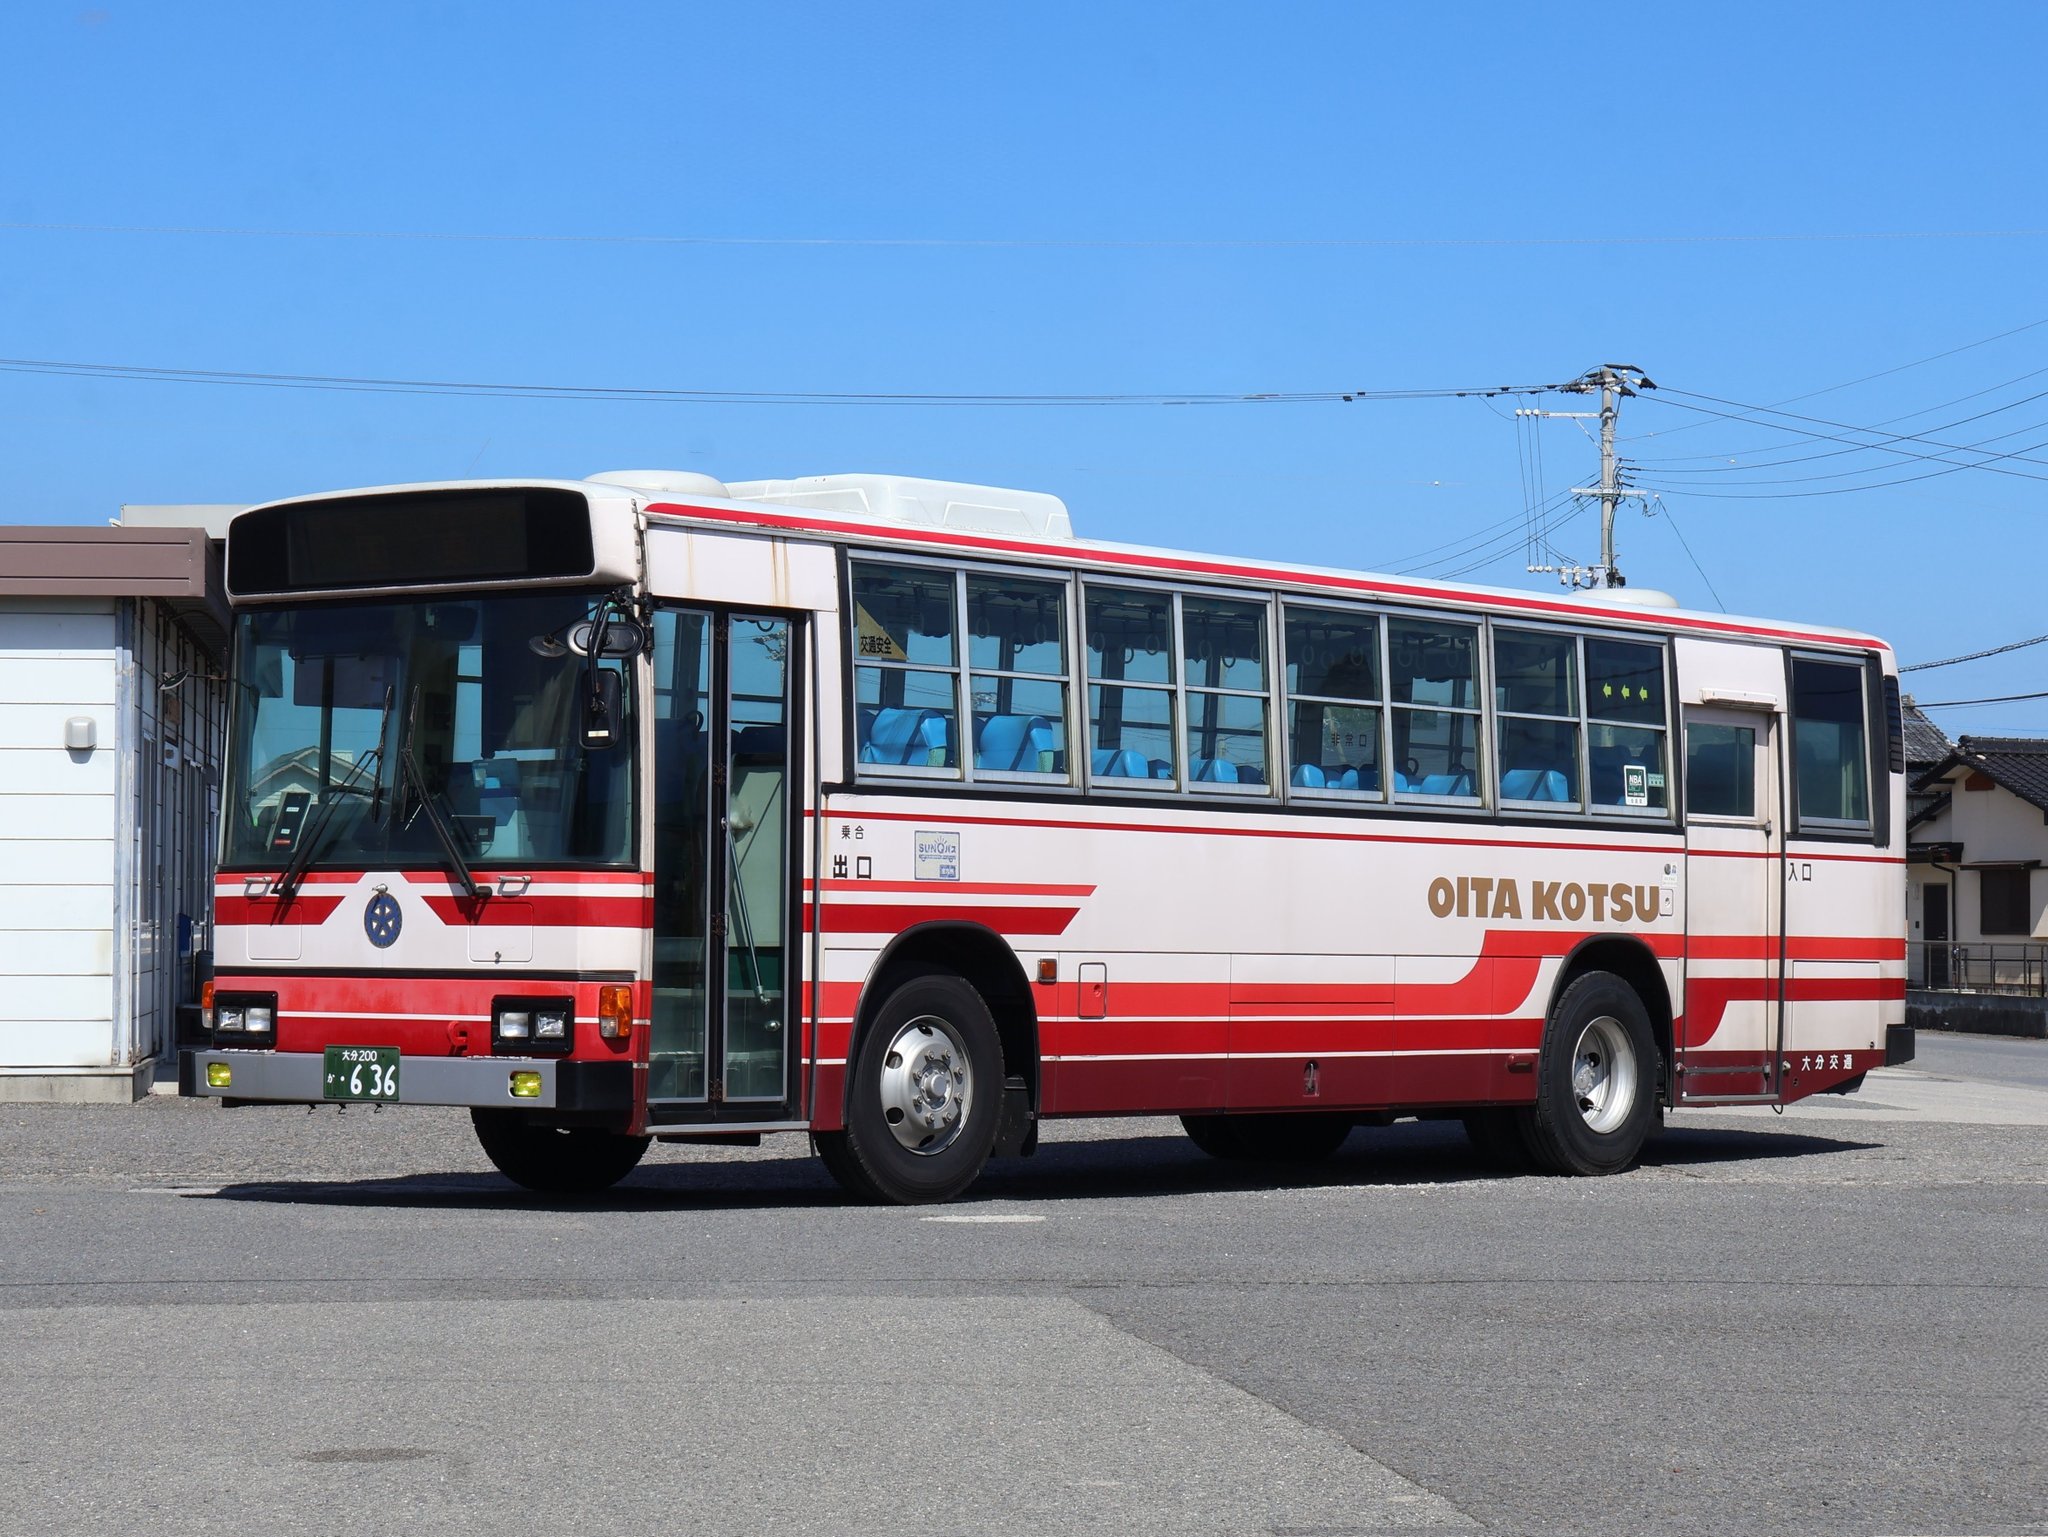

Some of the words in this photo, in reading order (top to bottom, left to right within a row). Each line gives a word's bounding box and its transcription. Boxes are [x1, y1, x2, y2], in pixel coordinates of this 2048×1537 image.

[860, 635, 892, 654] 交通安全
[841, 825, 864, 839] 乗合
[833, 854, 872, 879] 出口
[1788, 862, 1811, 881] 入口
[1428, 877, 1522, 919] OITA
[1532, 881, 1660, 923] KOTSU
[342, 1050, 377, 1062] 大分200
[1801, 1054, 1853, 1071] 大分交通
